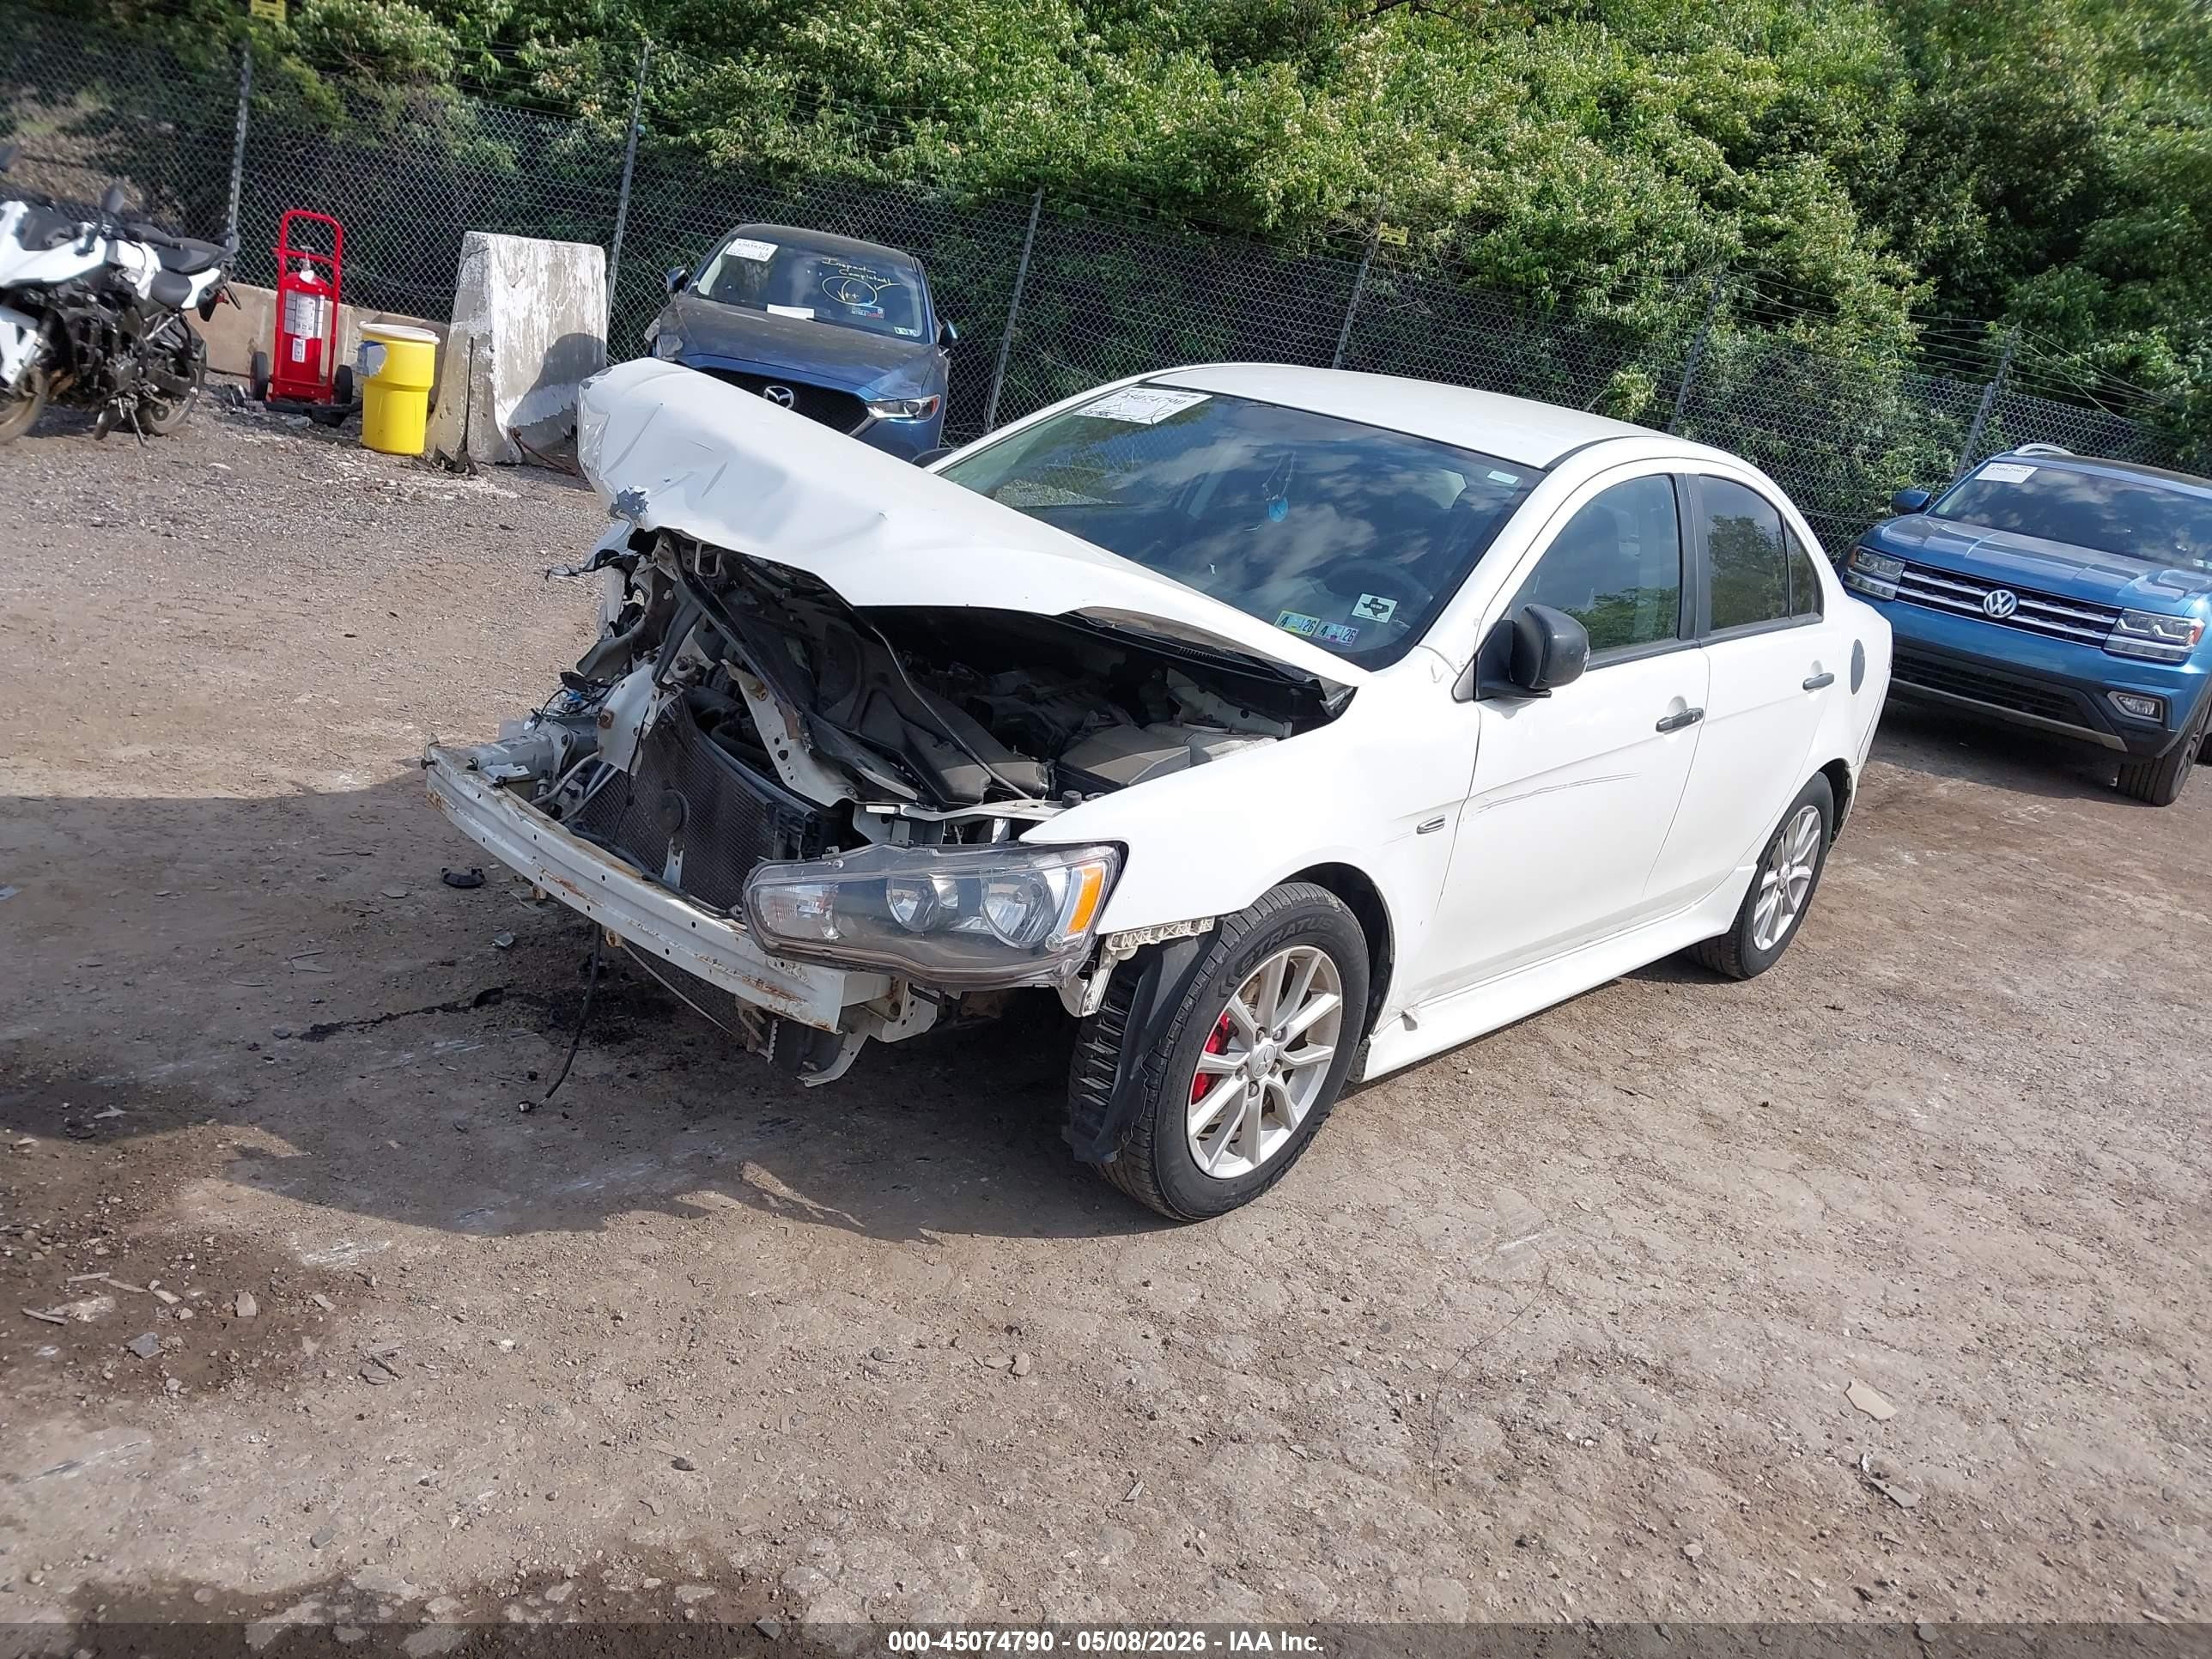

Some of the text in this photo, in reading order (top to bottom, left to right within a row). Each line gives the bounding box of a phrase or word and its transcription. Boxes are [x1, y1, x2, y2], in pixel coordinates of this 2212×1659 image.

[1984, 590, 2017, 617] VW
[1302, 619, 1316, 633] 26
[1342, 628, 1358, 642] 26
[1239, 915, 1334, 975] STRATUS
